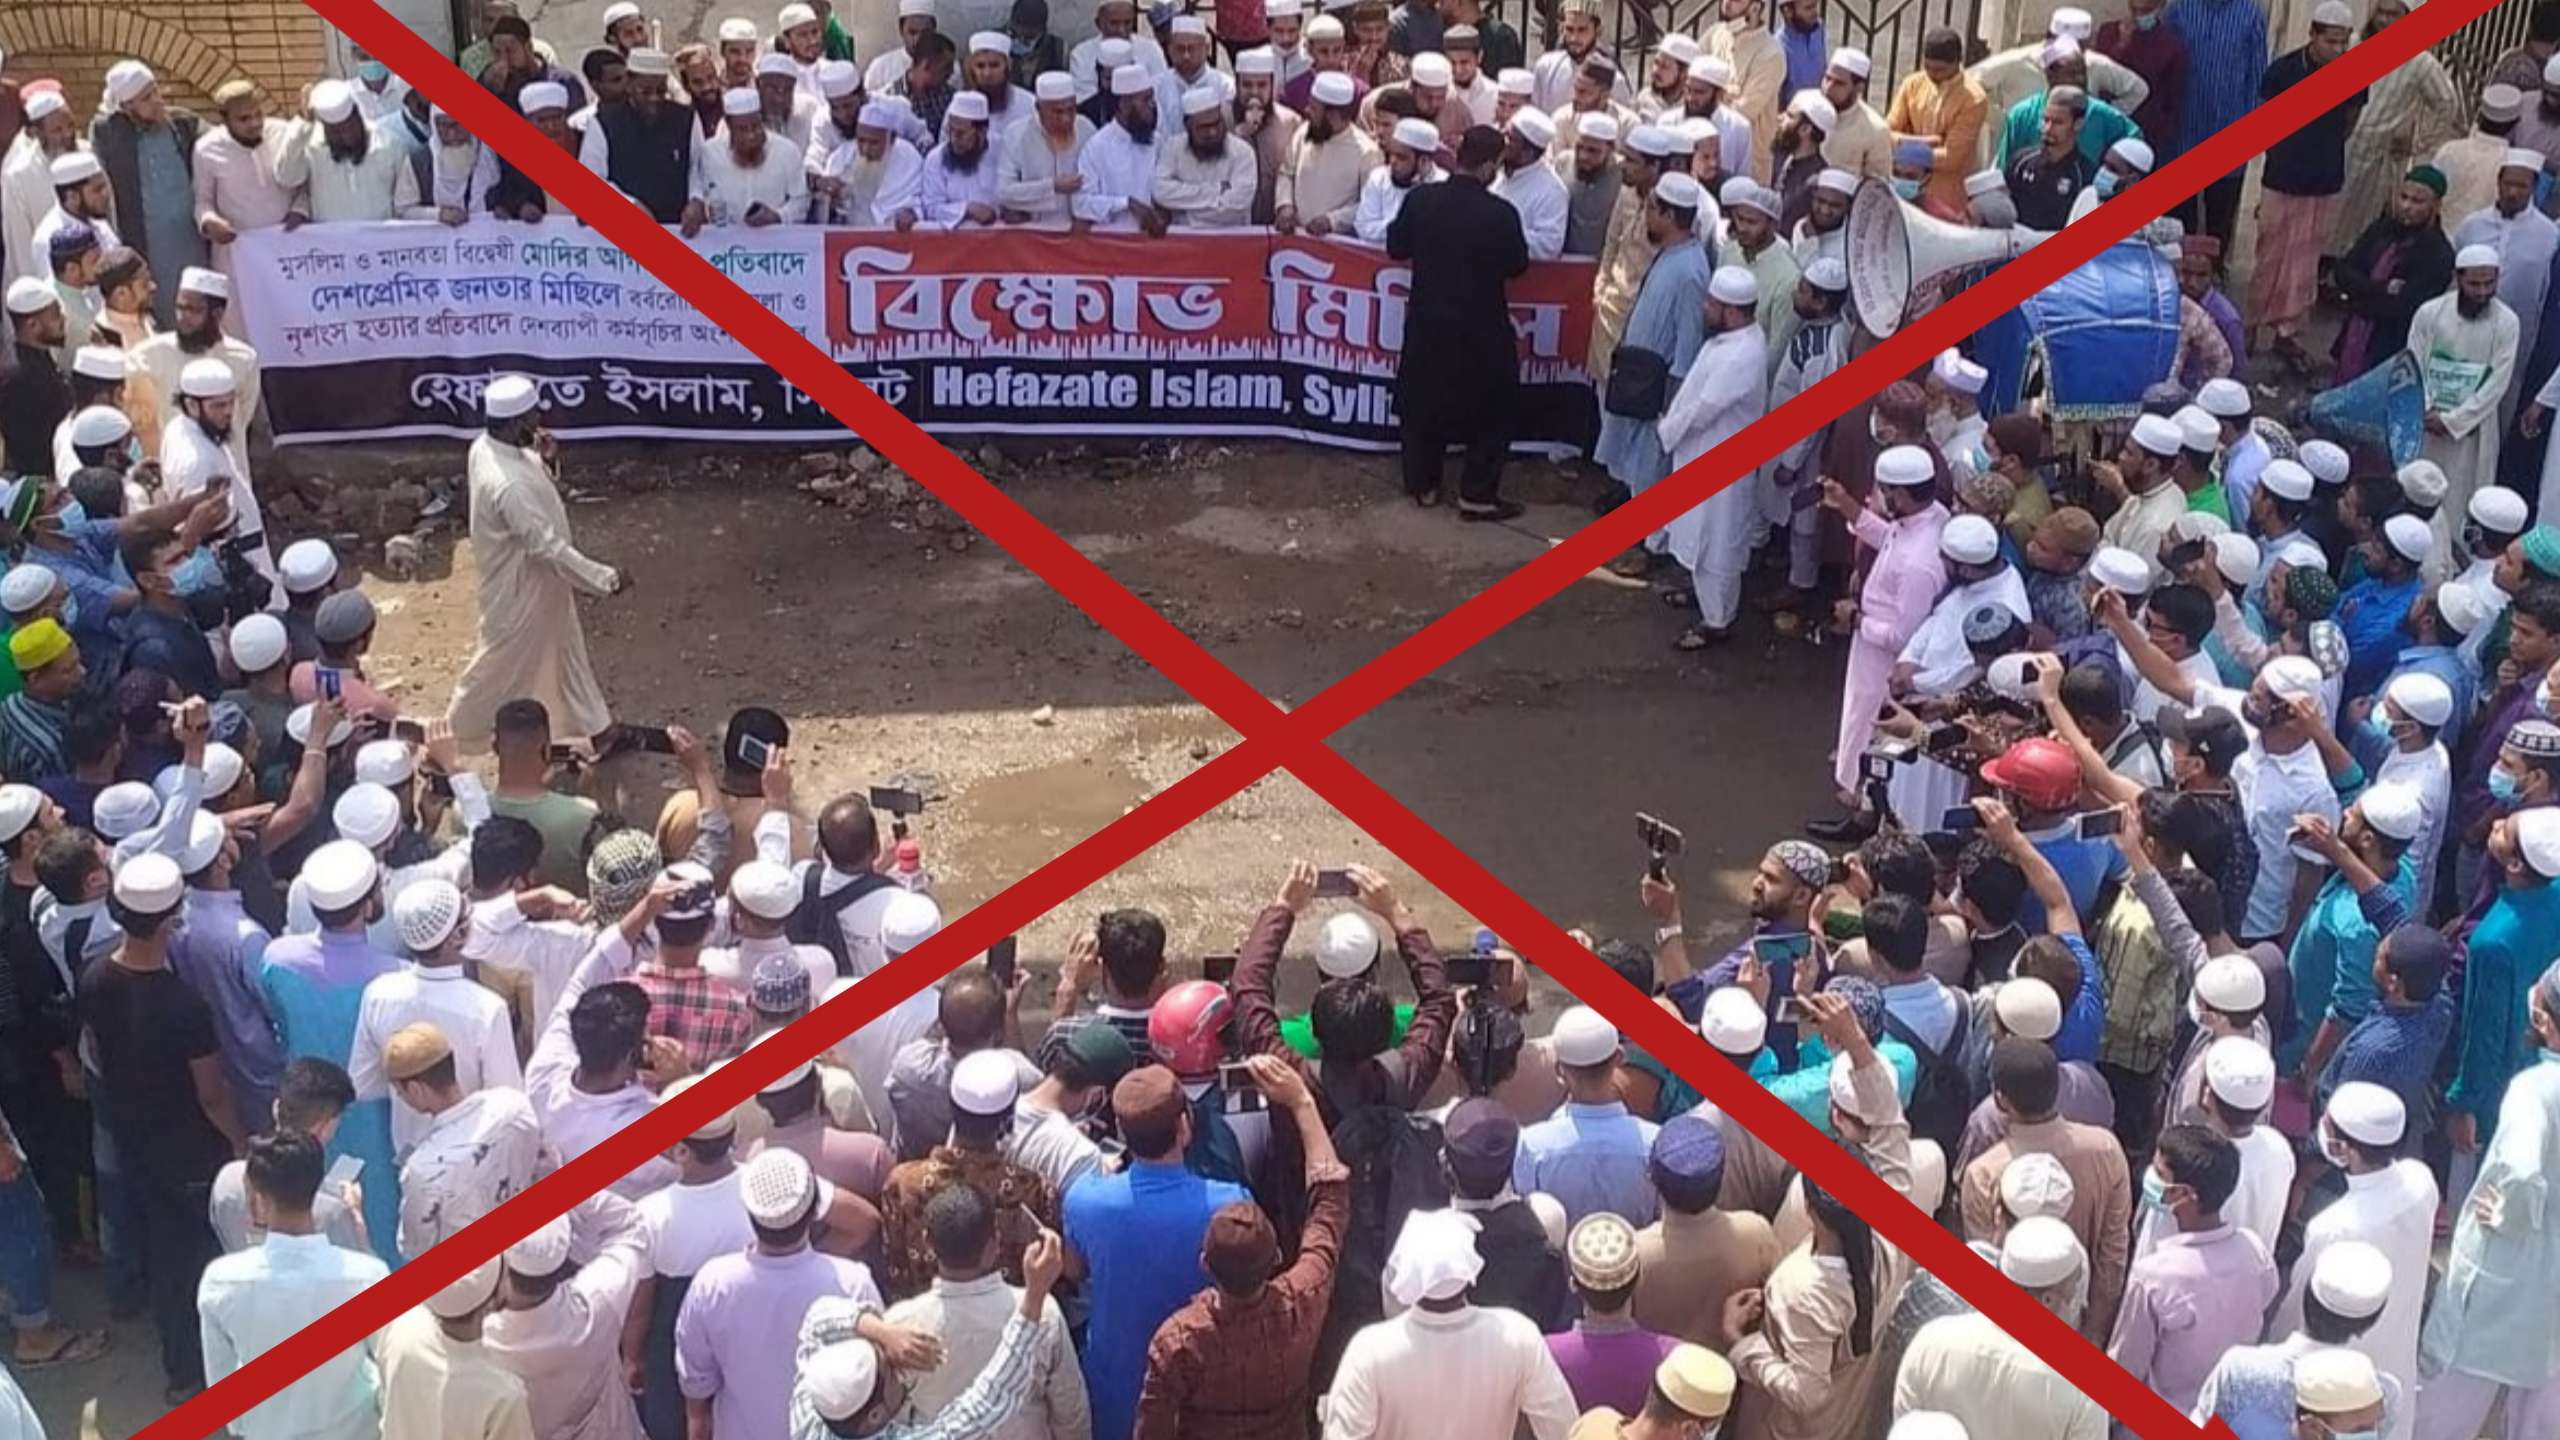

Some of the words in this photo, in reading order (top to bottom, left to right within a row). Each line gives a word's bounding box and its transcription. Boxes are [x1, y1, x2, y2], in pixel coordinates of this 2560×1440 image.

[278, 248, 345, 280] মুসলিম
[356, 253, 370, 270] ও
[377, 245, 448, 271] মানবতা
[521, 237, 589, 270] মোদির
[312, 272, 441, 311] দেশপ্রেমিক
[446, 275, 534, 304] জনতার
[540, 272, 622, 308] মিছিলে
[792, 293, 806, 311] ও
[841, 246, 1231, 340] বিক্ষোভ
[281, 321, 348, 357] নৃশংস
[354, 315, 419, 341] হত্যার
[426, 308, 513, 338] প্রতিবাদে
[520, 312, 599, 340] দেশব্যাপী
[605, 317, 683, 349] কর্মসূচির
[933, 366, 1138, 409] Hefazate
[1150, 368, 1293, 414] Islam,
